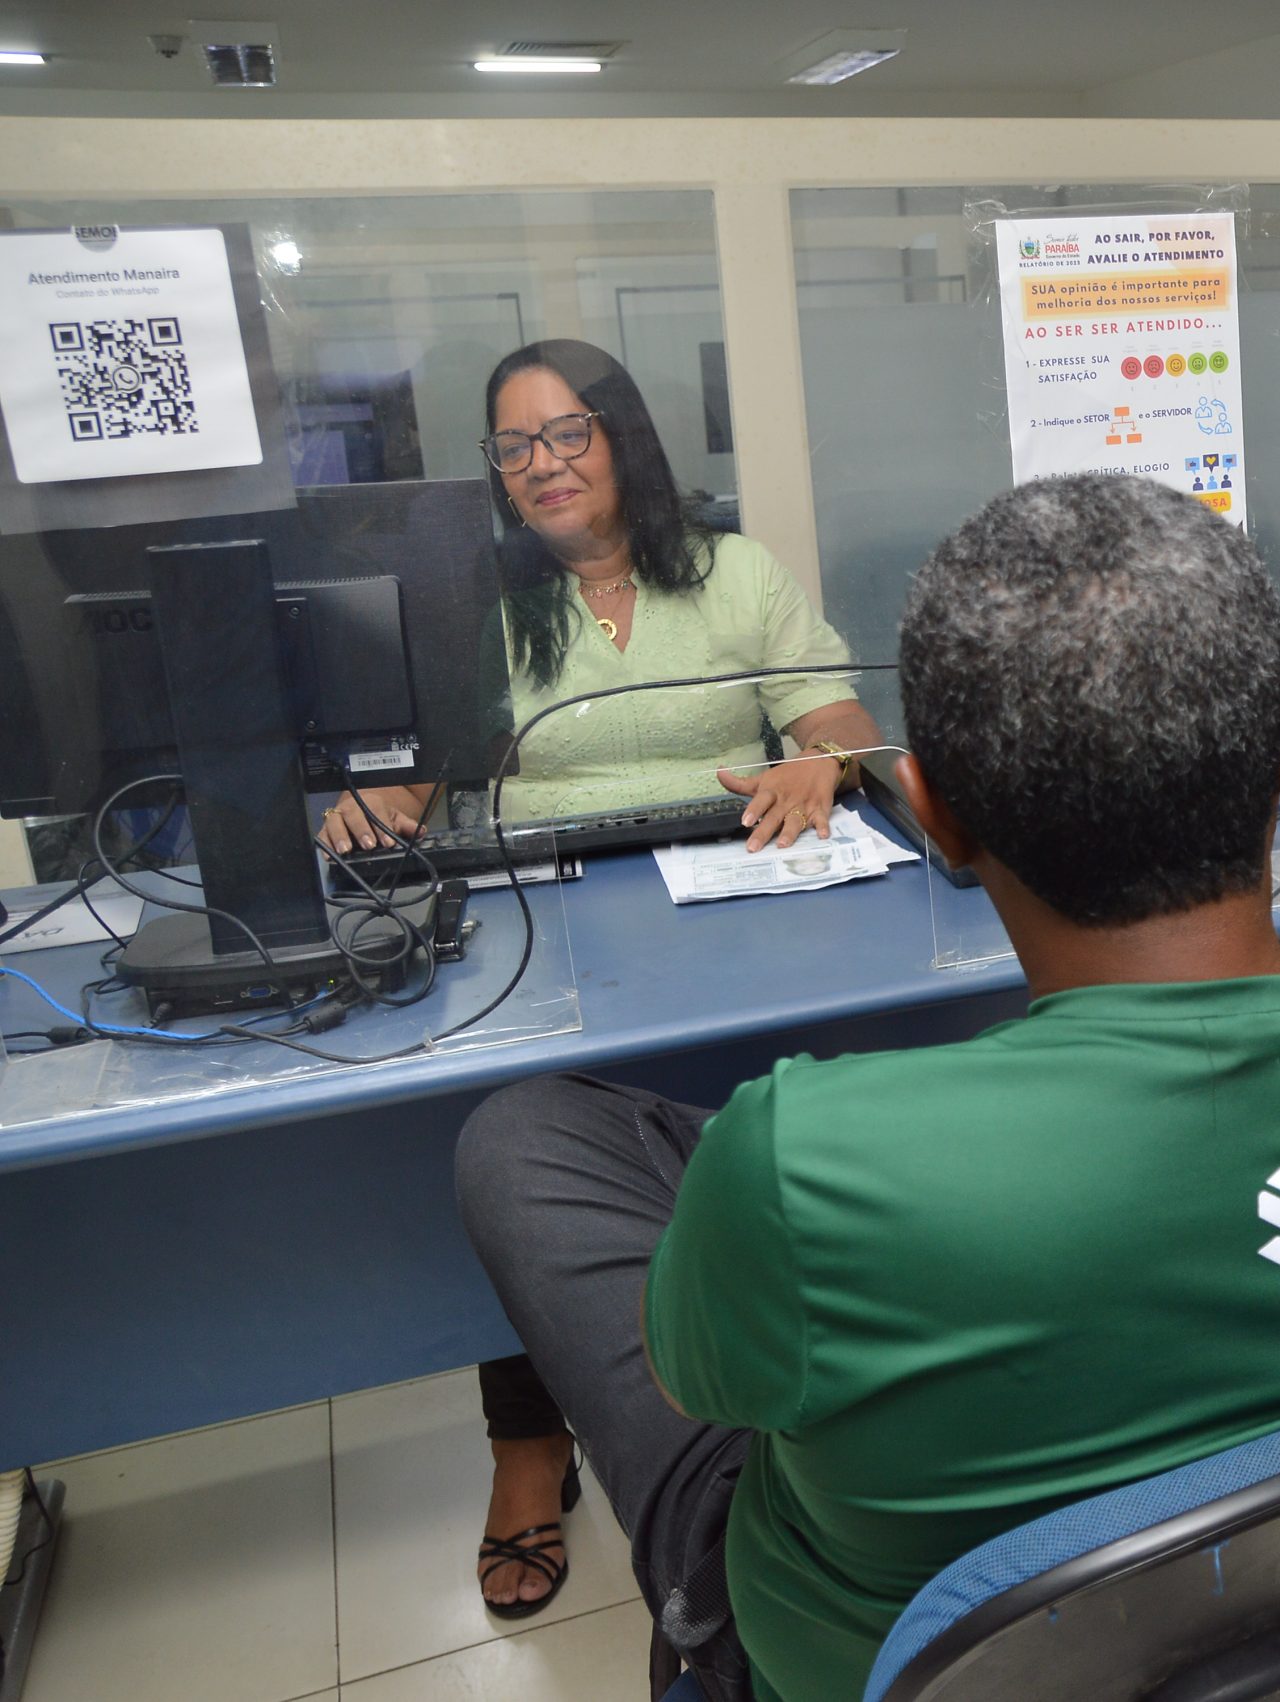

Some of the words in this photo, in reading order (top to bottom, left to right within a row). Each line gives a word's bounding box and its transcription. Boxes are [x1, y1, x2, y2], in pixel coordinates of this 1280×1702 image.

[1094, 234, 1111, 244] AO
[1115, 233, 1145, 244] SAIR,
[1149, 232, 1171, 242] POR
[1175, 230, 1215, 242] FAVOR,
[1045, 242, 1080, 253] PARAÍBA
[1019, 260, 1054, 268] RELATÓRIO
[1087, 253, 1128, 264] AVALIE
[1132, 253, 1140, 262] O
[1143, 250, 1224, 262] ATENDIMENTO
[28, 269, 120, 285] Atendimento
[123, 268, 180, 281] Manaira
[56, 289, 95, 299] Contato
[97, 288, 109, 297] do
[111, 286, 160, 297] WhatsApp
[1031, 284, 1056, 296] SUA
[1060, 281, 1107, 294] opinião
[1112, 281, 1118, 291] é
[1122, 279, 1189, 292] importante
[1192, 278, 1221, 290] para
[1037, 298, 1092, 310] melhoria
[1096, 296, 1117, 306] dos
[1121, 295, 1161, 305] nossos
[1165, 291, 1217, 305] serviços!
[1025, 327, 1047, 340] AO
[1055, 324, 1083, 337] SER
[1091, 322, 1119, 335] SER
[1126, 318, 1222, 334] ATENDIDO...
[1039, 356, 1086, 368] EXPRESSE
[1091, 355, 1110, 365] SUA
[1038, 371, 1097, 383] SATISFAÇÃO
[1030, 419, 1037, 428] 2
[1043, 417, 1075, 428] Indique
[1083, 413, 1110, 424] SETOR
[1152, 407, 1192, 418] SERVIDOR
[1133, 462, 1170, 473] ELOGIO
